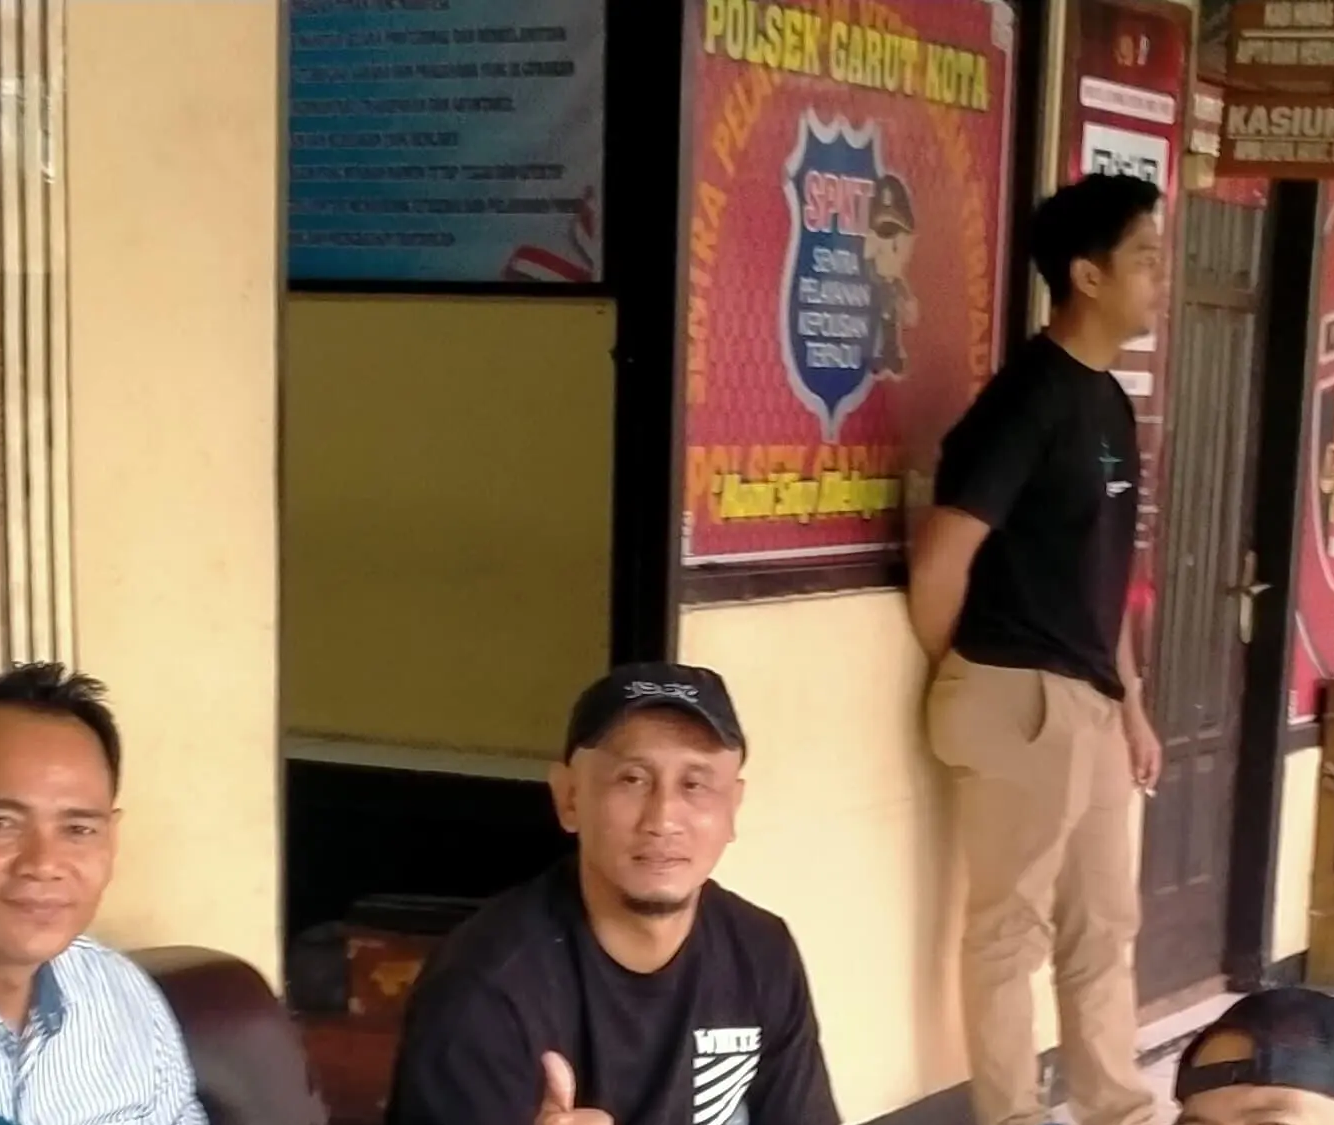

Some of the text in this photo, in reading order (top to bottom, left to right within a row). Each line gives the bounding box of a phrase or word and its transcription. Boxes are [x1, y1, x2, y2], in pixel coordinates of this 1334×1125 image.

[704, 0, 821, 76] POLSEK
[829, 20, 919, 97] GARUT
[925, 42, 990, 112] KOTA
